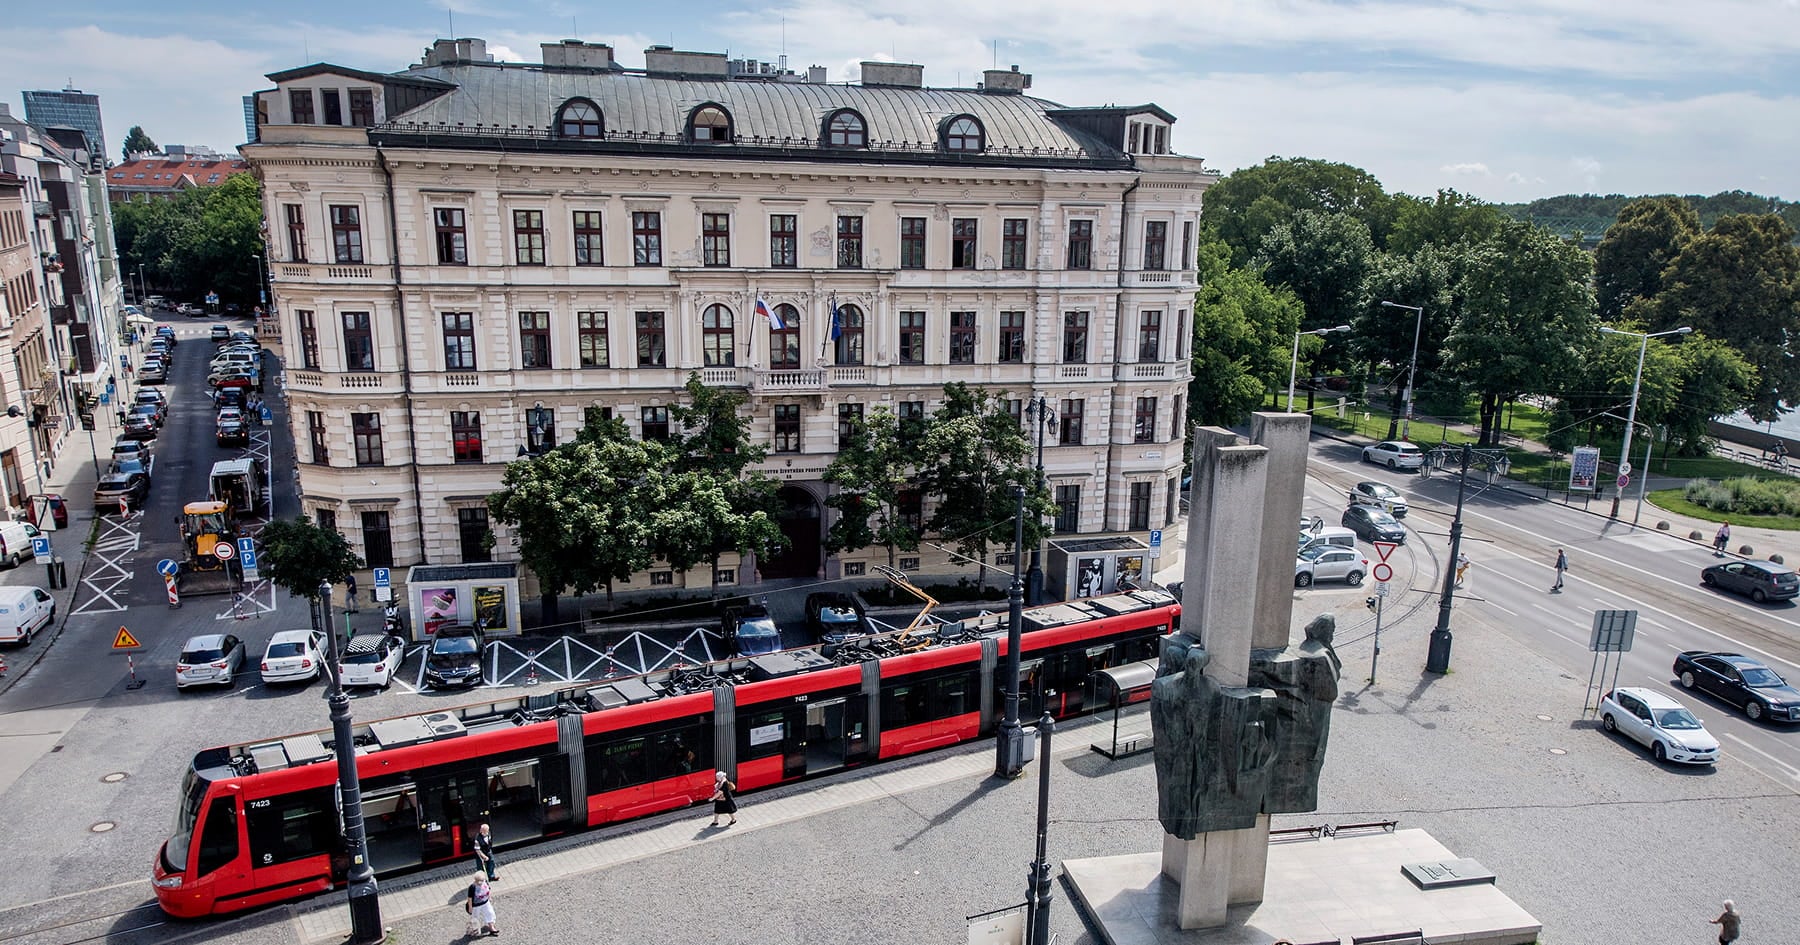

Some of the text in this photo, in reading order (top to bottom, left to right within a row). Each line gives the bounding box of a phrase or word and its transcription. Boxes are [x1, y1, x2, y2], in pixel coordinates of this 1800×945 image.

[1152, 531, 1159, 541] P
[35, 540, 44, 551] P
[244, 553, 252, 564] P
[378, 570, 385, 579] P
[794, 695, 808, 703] 7423
[250, 799, 271, 809] 7423
